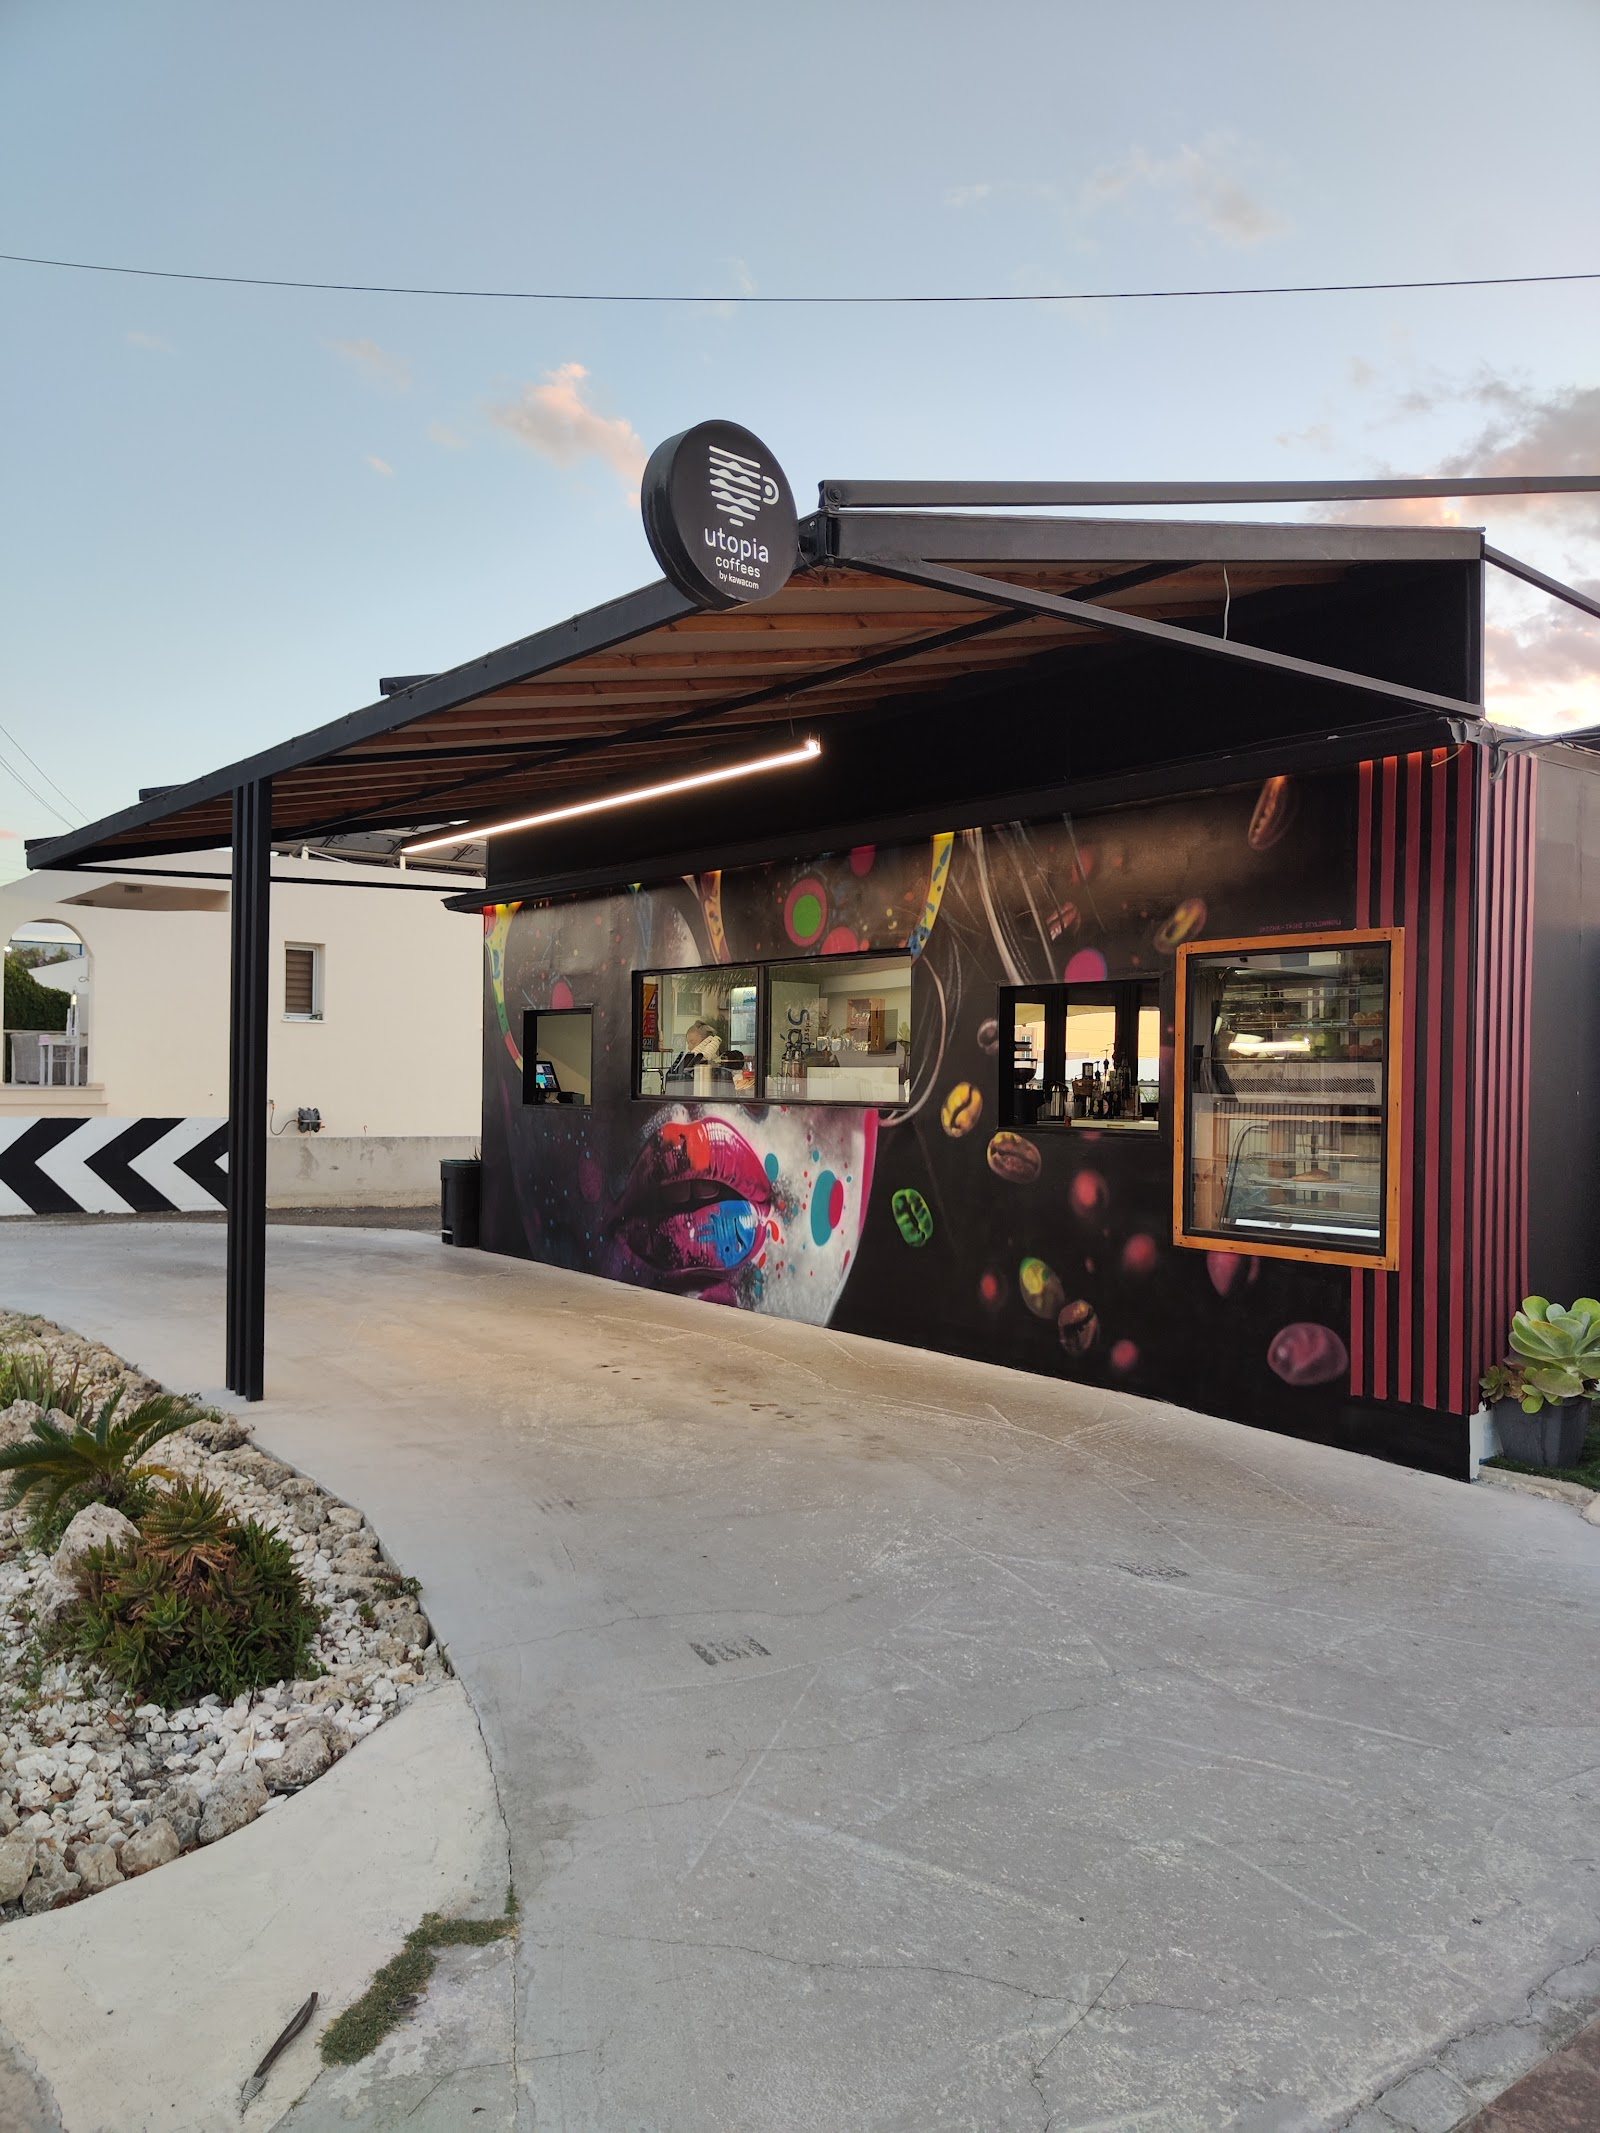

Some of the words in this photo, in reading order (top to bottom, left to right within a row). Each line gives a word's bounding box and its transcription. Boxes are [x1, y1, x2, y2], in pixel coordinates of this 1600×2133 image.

[705, 528, 768, 563] utopia
[716, 557, 760, 577] coffees
[719, 570, 728, 582] by
[729, 573, 759, 589] kawacom
